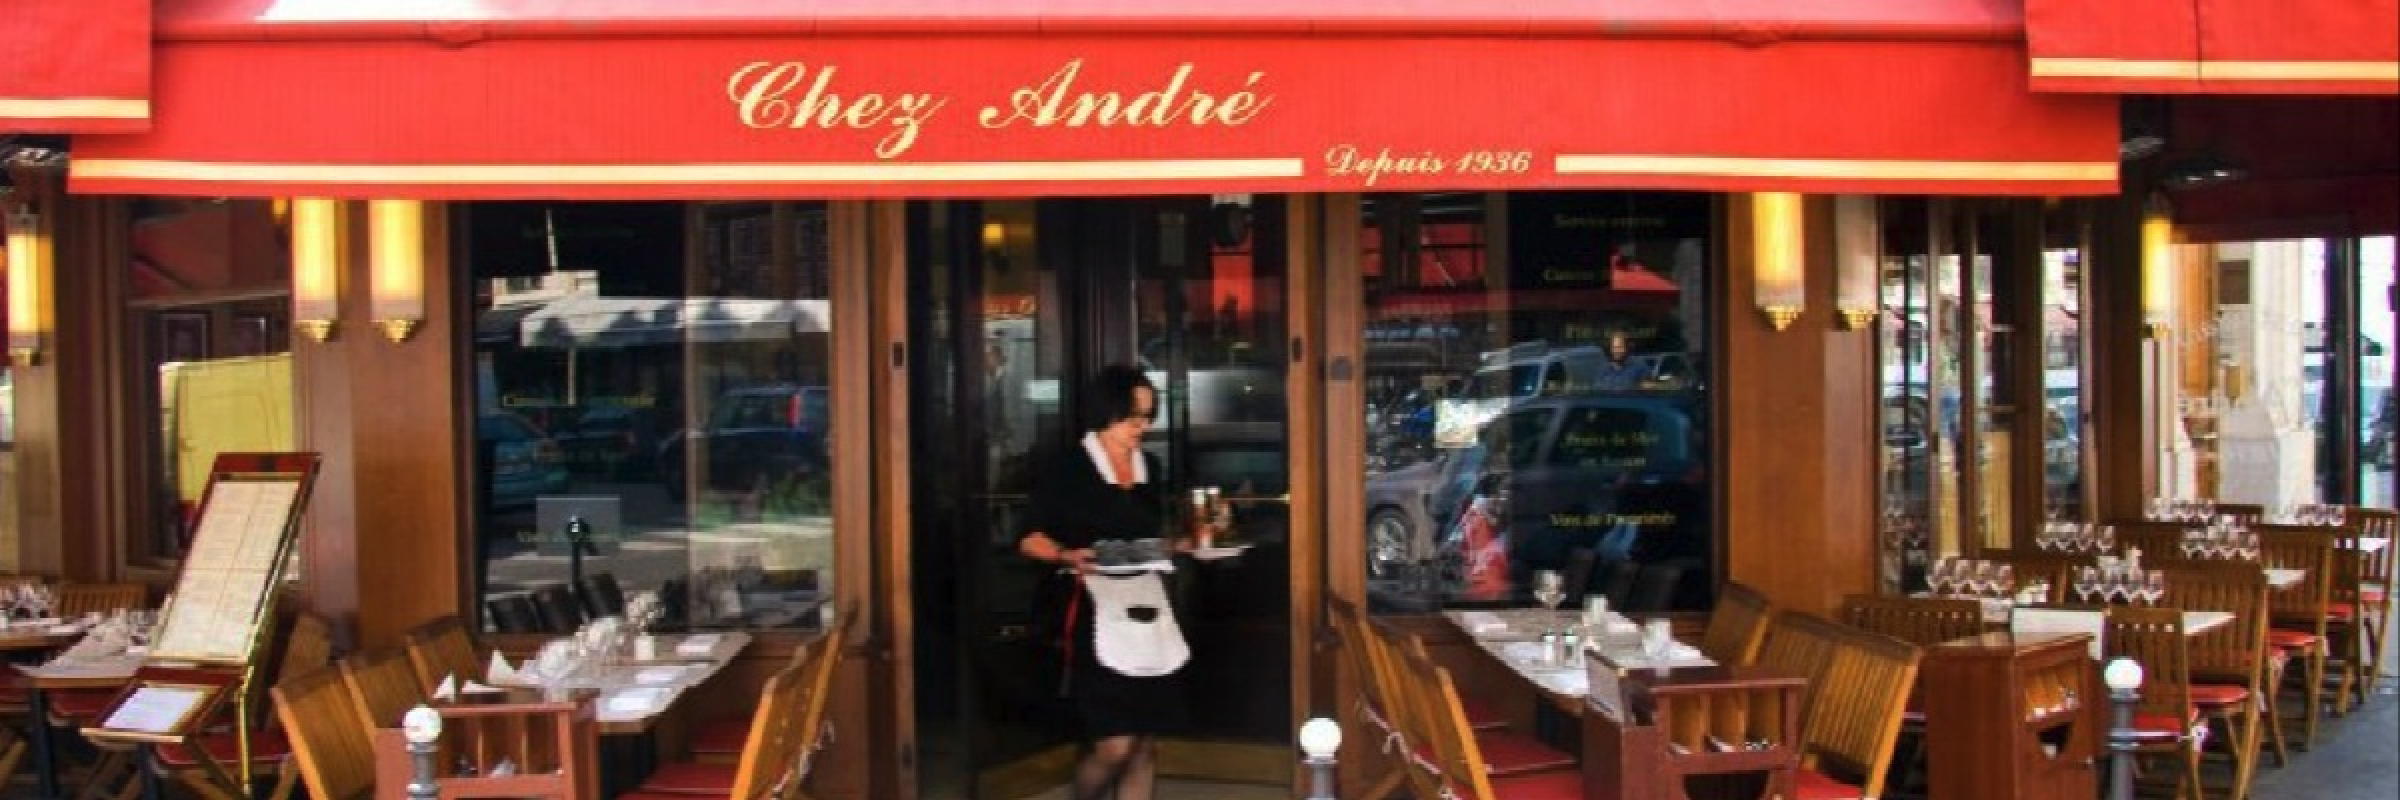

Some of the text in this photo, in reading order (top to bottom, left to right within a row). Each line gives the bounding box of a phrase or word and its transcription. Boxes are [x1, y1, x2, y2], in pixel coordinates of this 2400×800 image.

[727, 58, 1275, 159] Chez André
[1324, 143, 1533, 187] Depuis 1936
